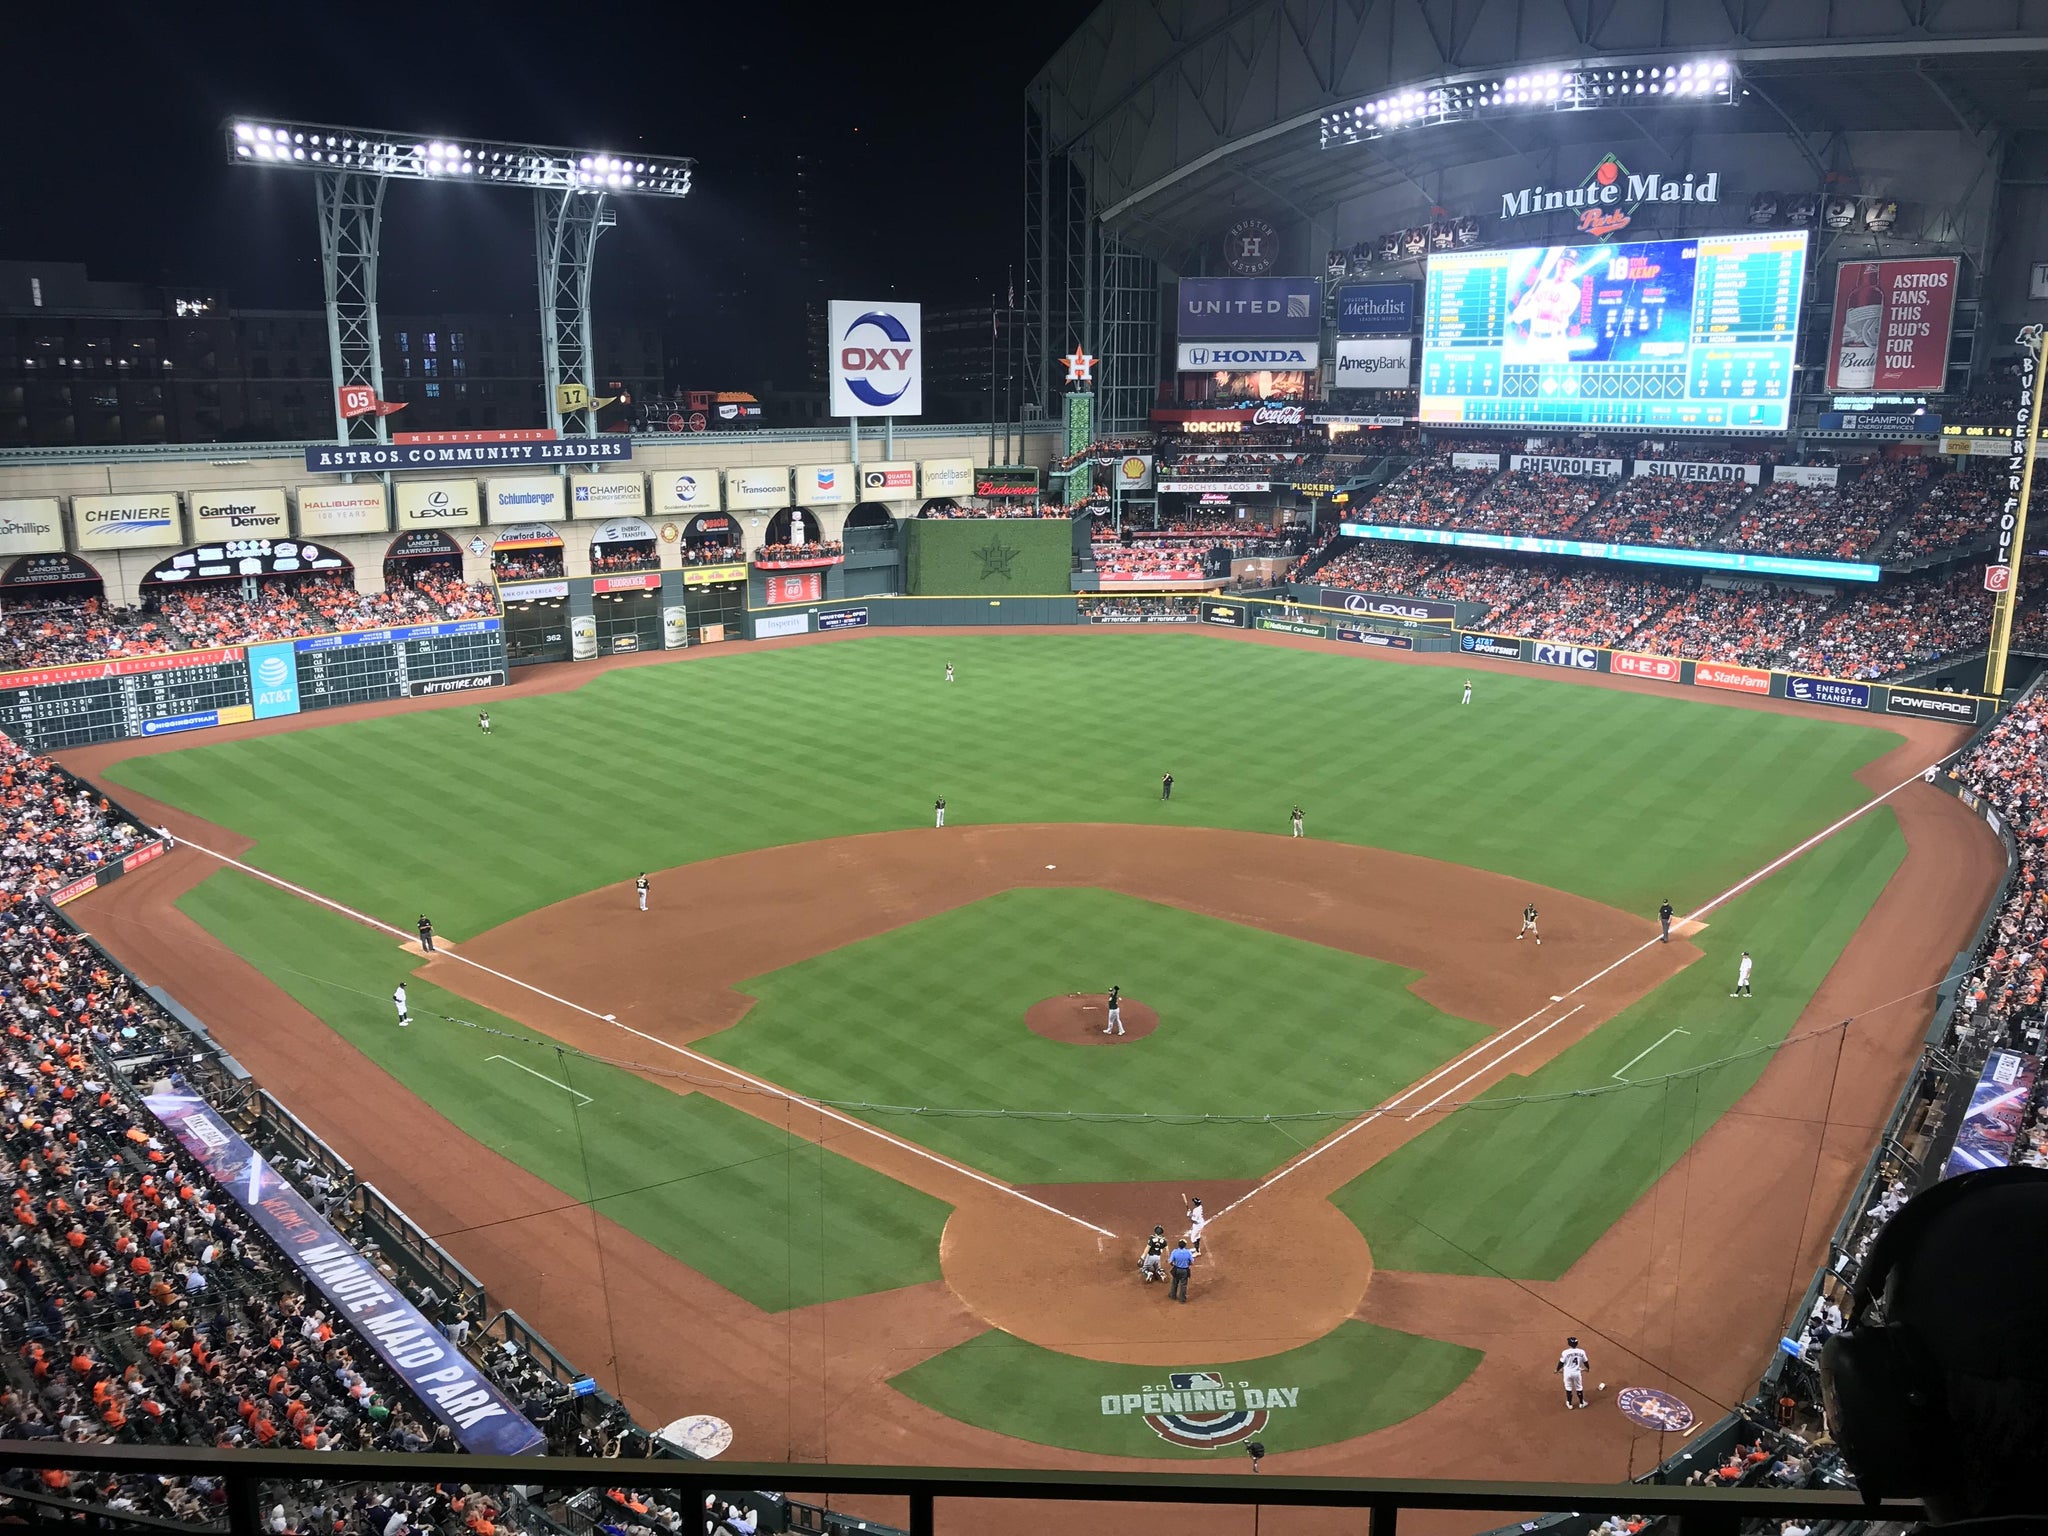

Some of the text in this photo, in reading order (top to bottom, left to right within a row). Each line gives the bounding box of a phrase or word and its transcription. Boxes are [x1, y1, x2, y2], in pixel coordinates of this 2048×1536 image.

[1500, 172, 1719, 219] Minute Maid
[1231, 220, 1272, 236] HOUSTON
[1577, 208, 1631, 234] Park
[1242, 237, 1261, 257] H
[1682, 248, 1696, 259] DH
[1231, 259, 1270, 272] ASTROS
[1607, 256, 1629, 280] 18
[1628, 265, 1661, 279] KEMP
[1893, 273, 1948, 289] ASTROS
[1892, 290, 1930, 306] FANS,
[1189, 300, 1281, 314] UNITED
[1344, 299, 1405, 315] Methodist
[1890, 306, 1922, 321] THIS
[1888, 323, 1930, 337] BUD'S
[1886, 339, 1914, 353] FOR
[841, 348, 913, 371] OXY
[1213, 350, 1306, 362] HONDA
[1885, 355, 1916, 369] YOU.
[1338, 356, 1407, 372] AmegyBank
[347, 392, 369, 408] 05
[564, 390, 581, 404] 17
[1253, 406, 1305, 425] Coca-Cola
[1858, 416, 1915, 425] CHAMPION
[1183, 422, 1242, 432] TORCHYS
[412, 433, 483, 441] MINUTE
[409, 446, 533, 462] COMMUNITY
[542, 443, 621, 457] LEADERS
[1948, 442, 1969, 450] smile
[1520, 458, 1612, 476] CHEVROLET
[1649, 463, 1746, 482] SILVERADO
[590, 485, 641, 494] CHAMPION
[676, 485, 696, 493] OXY
[742, 485, 786, 494] Transocean
[976, 482, 1038, 495] Budweiser
[1292, 483, 1335, 491] PLUCKERS
[304, 499, 380, 509] HALLIBURTON
[498, 493, 554, 506] Schlumberger
[86, 508, 170, 522] CHENIERE
[199, 504, 256, 517] Gardner
[341, 510, 366, 518] YEARS
[410, 508, 468, 519] LEXUS
[231, 516, 280, 527] Denver
[501, 530, 554, 541] Crawford Bock
[397, 547, 431, 555] CRAWFORD
[27, 565, 70, 573] LANDRY'S
[14, 572, 86, 583] CRAWFORD BOXES
[787, 587, 800, 595] 66
[1369, 602, 1428, 618] LEXUS
[1270, 622, 1292, 632] National
[1302, 627, 1319, 635] Rental
[546, 634, 562, 642] 362
[1475, 645, 1518, 656] SPORTSNET
[1536, 644, 1595, 667] RTIC
[127, 651, 219, 670] BEYOND LIMITS
[1621, 658, 1670, 675] H-E-B
[55, 668, 100, 679] LIMITS
[424, 675, 491, 694] NITTOTIRE.COM
[1816, 684, 1854, 696] ENERGY
[259, 689, 292, 705] AT&T
[1816, 693, 1863, 705] TRANSFER
[1891, 695, 1972, 714] POWERADE
[76, 877, 96, 893] FARGO
[298, 1243, 506, 1430] MINUTE MAID PARK
[1572, 1357, 1578, 1365] 4
[1101, 1387, 1300, 1415] OPENING DAY
